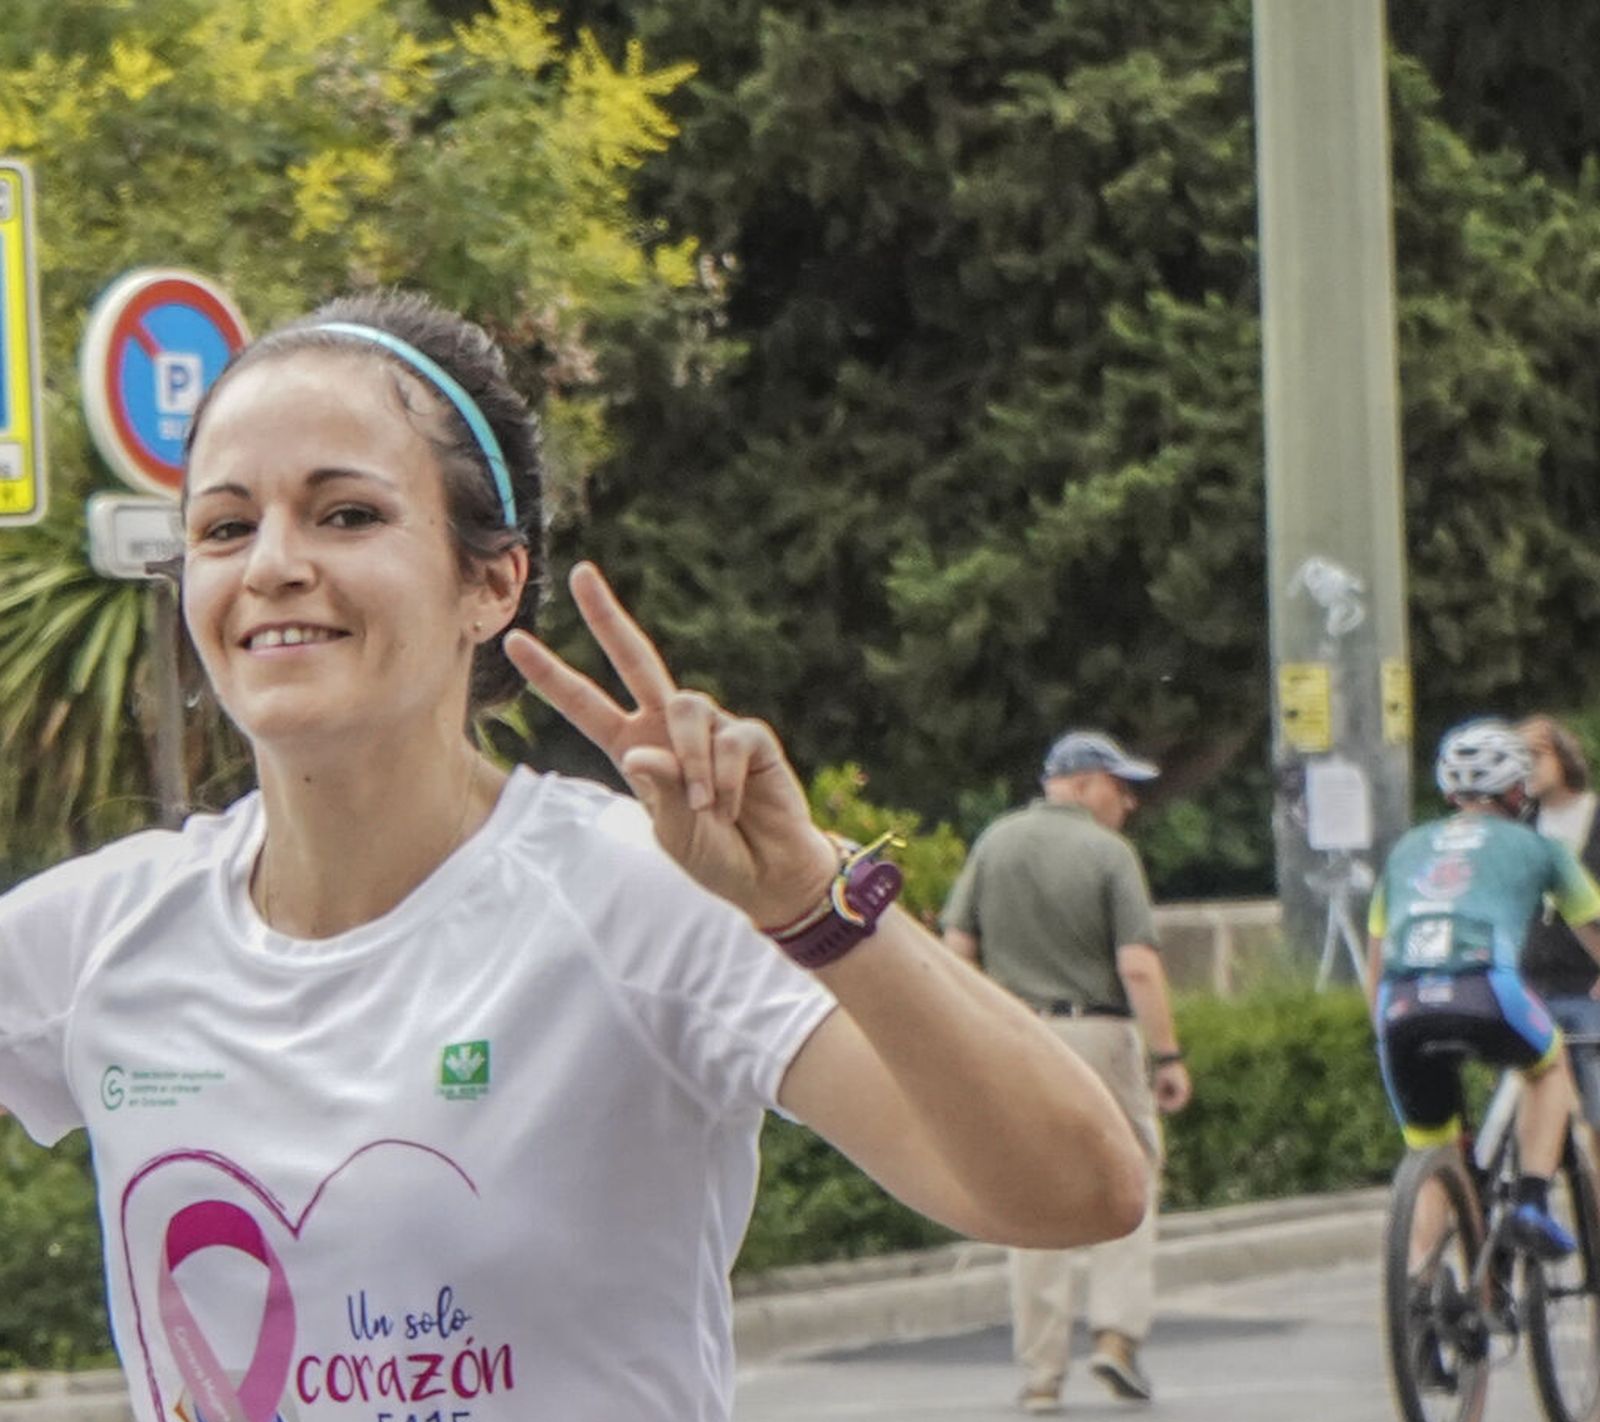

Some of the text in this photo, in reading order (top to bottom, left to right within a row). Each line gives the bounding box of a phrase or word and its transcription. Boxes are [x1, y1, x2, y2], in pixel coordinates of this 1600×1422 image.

[169, 364, 190, 404] P
[348, 1286, 472, 1341] Un solo
[296, 1336, 514, 1404] corazón
